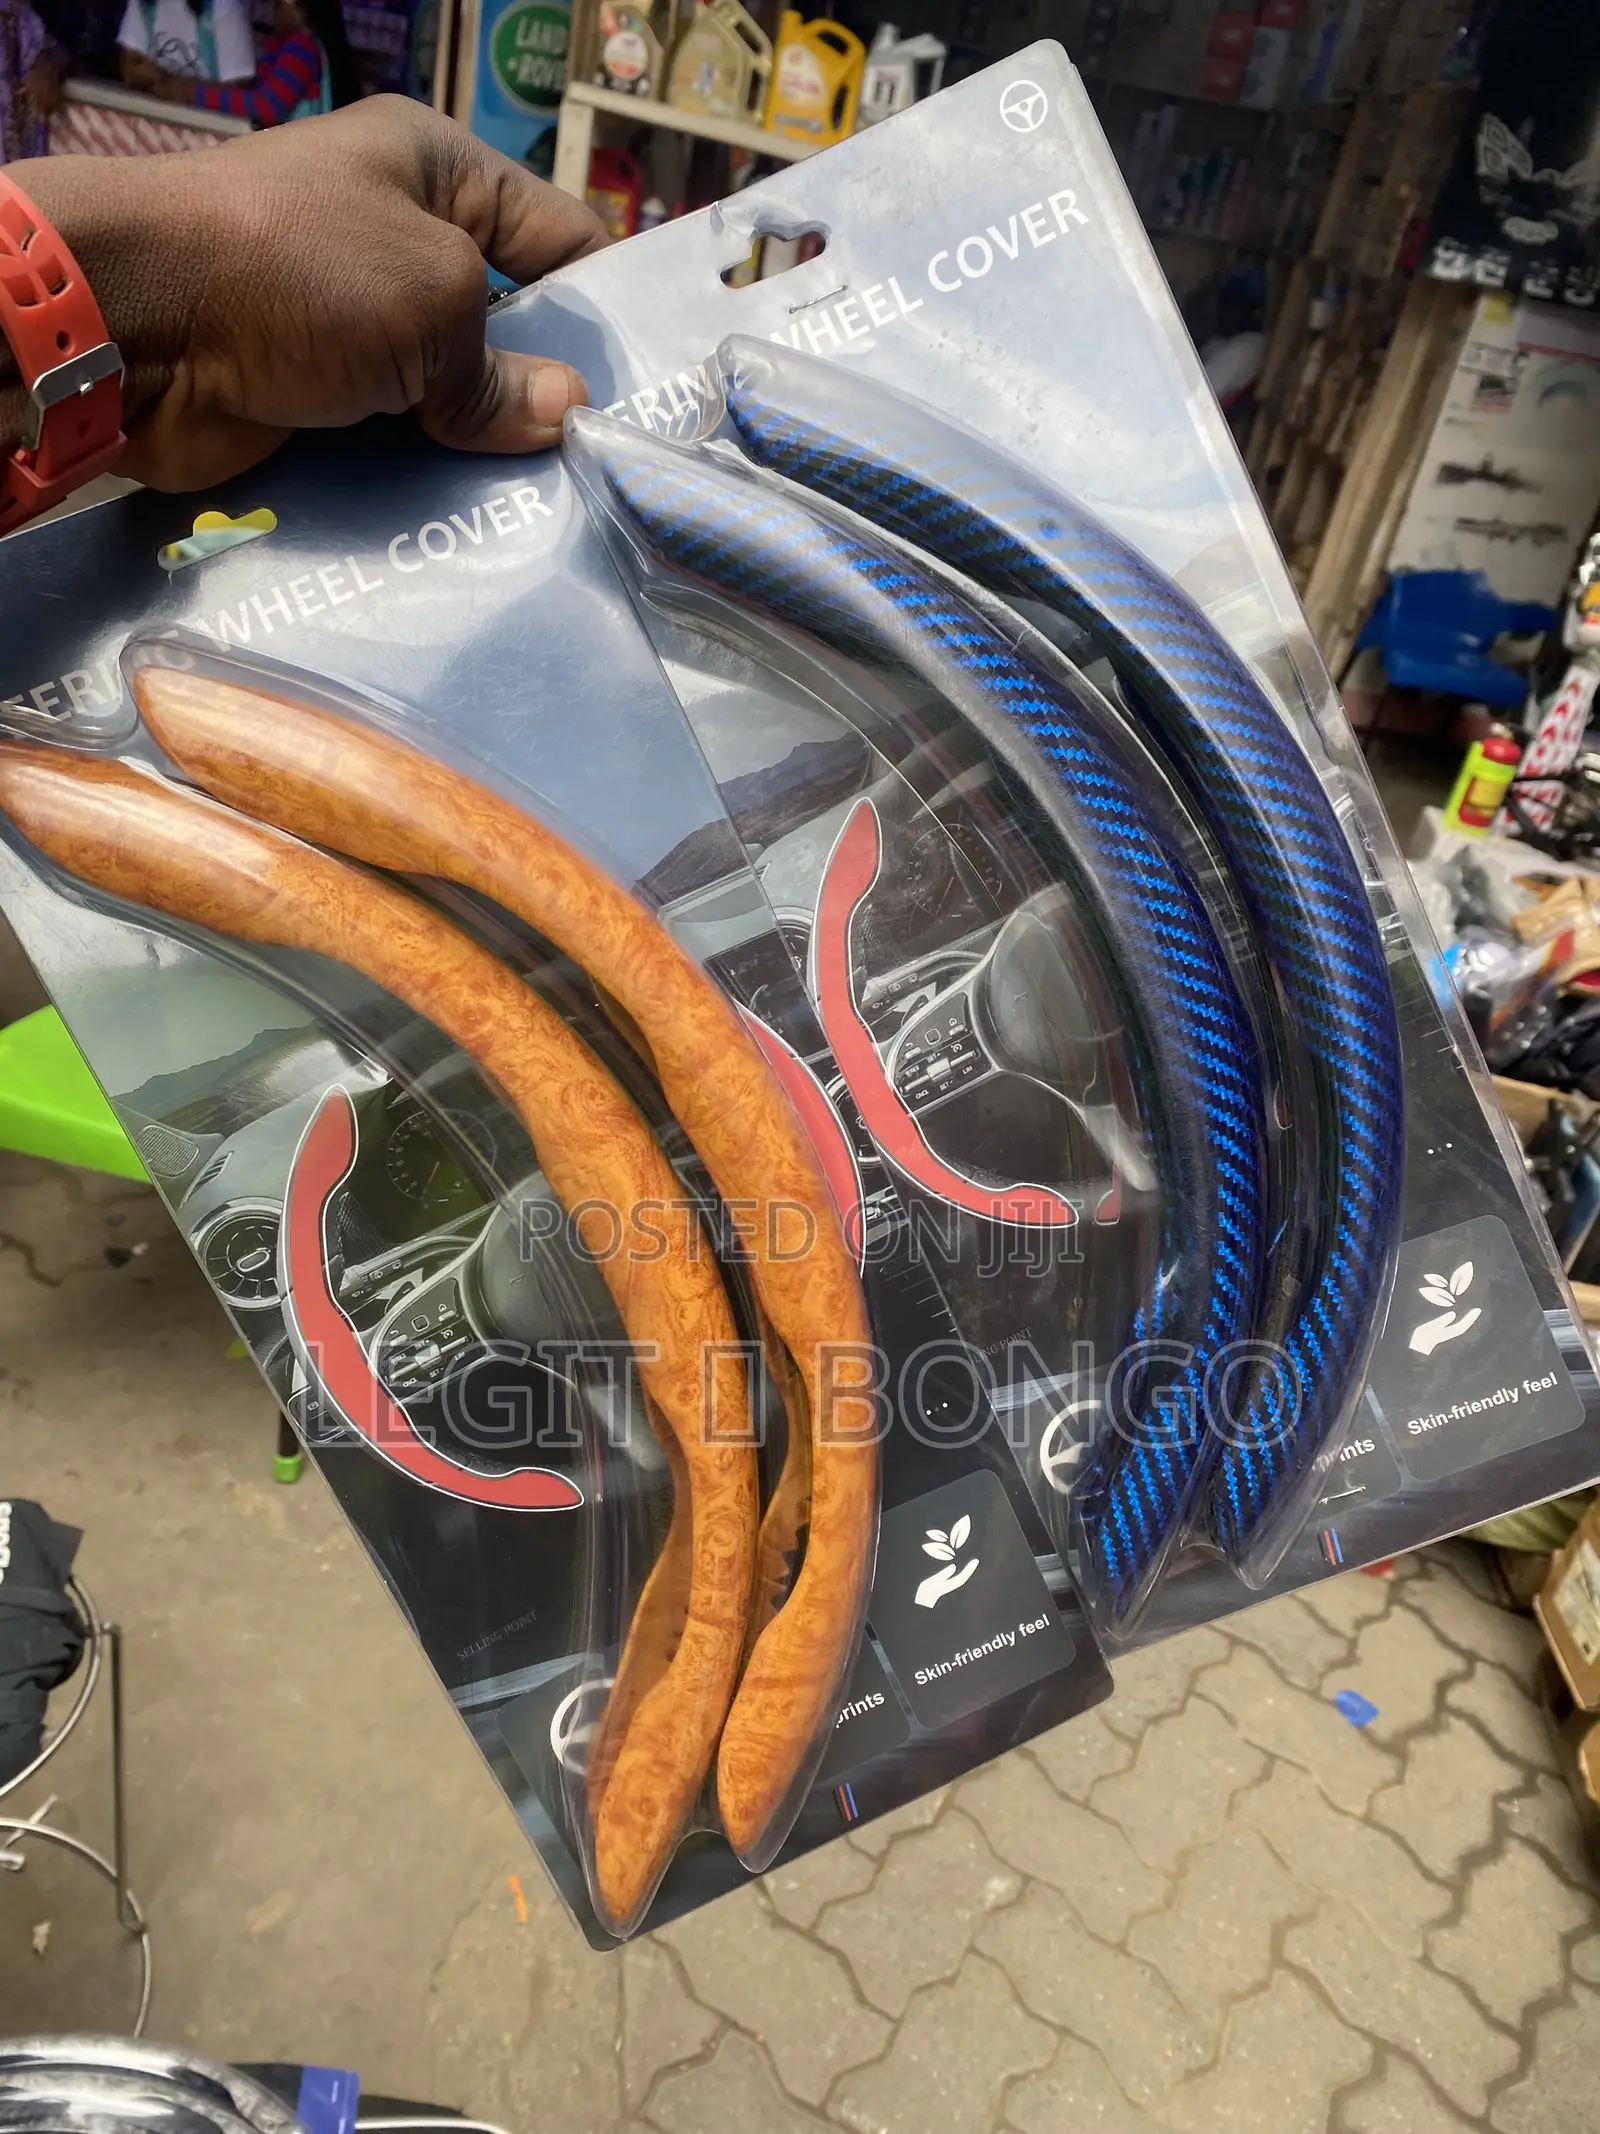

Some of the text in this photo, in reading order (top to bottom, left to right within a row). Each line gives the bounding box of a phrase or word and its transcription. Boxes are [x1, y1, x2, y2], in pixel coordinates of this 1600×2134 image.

[927, 188, 1089, 293] COVER
[387, 485, 554, 574] COVER
[1407, 1371, 1559, 1436] Skin-friendly feel
[914, 1613, 1051, 1686] Skin-friendly feel
